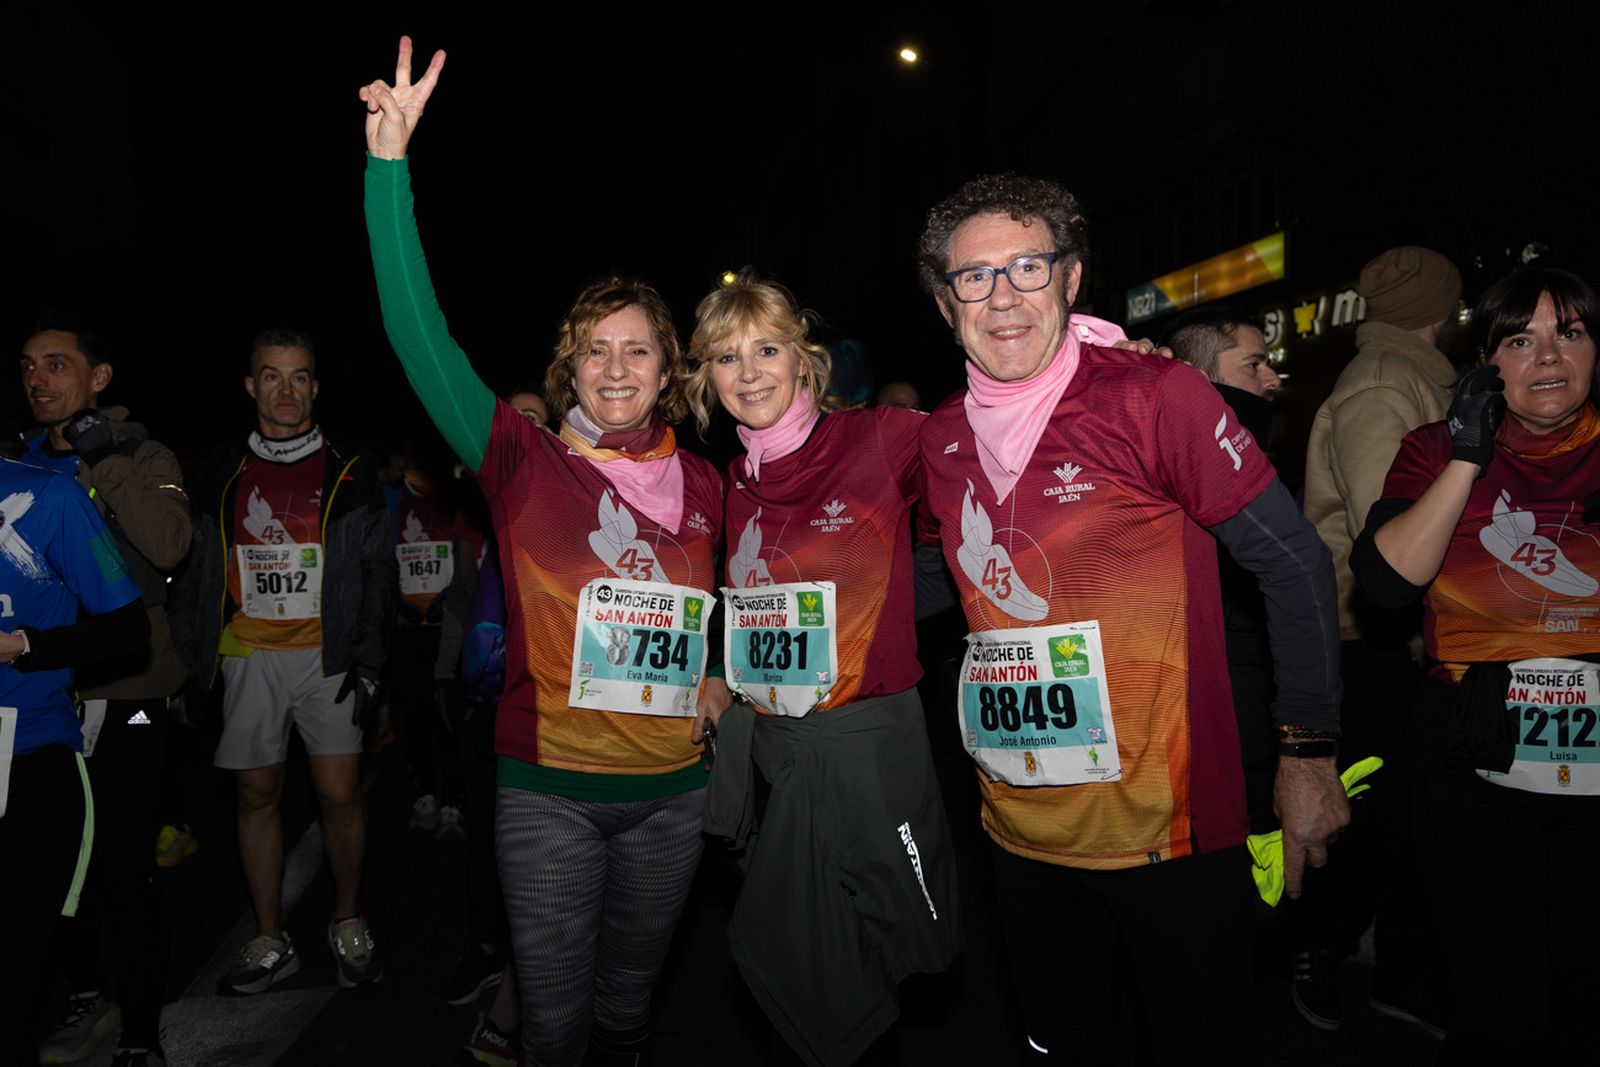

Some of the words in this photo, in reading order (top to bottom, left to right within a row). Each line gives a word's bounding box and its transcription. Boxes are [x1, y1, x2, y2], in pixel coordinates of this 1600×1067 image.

[408, 561, 440, 576] 1647
[615, 548, 654, 582] 43
[1509, 542, 1555, 576] 43
[256, 571, 307, 594] 5012
[982, 558, 1012, 601] 43
[613, 593, 656, 609] NOCHE
[659, 598, 675, 612] DE
[745, 598, 776, 611] NOCHE
[777, 597, 787, 610] DE
[595, 607, 625, 624] SAN
[627, 609, 674, 629] ANTÓN
[739, 614, 757, 628] SAN
[758, 610, 787, 627] ANTÓN
[1544, 619, 1580, 634] SAN
[606, 626, 689, 672] 8734
[749, 630, 808, 670] 8231
[982, 648, 1015, 663] NOCHE
[1017, 646, 1035, 661] DE
[627, 670, 642, 680] Eva
[969, 666, 989, 682] SAN
[990, 661, 1038, 682] ANTÓN
[1516, 673, 1564, 687] NOCHE
[1567, 673, 1585, 687] DE
[1506, 687, 1529, 702] AN
[1531, 688, 1586, 705] ANTÓN
[979, 683, 1078, 732] 8849
[1506, 705, 1600, 748] 1212
[999, 735, 1018, 747] José
[1020, 734, 1057, 747] Antonio
[1549, 751, 1578, 761] Luisa
